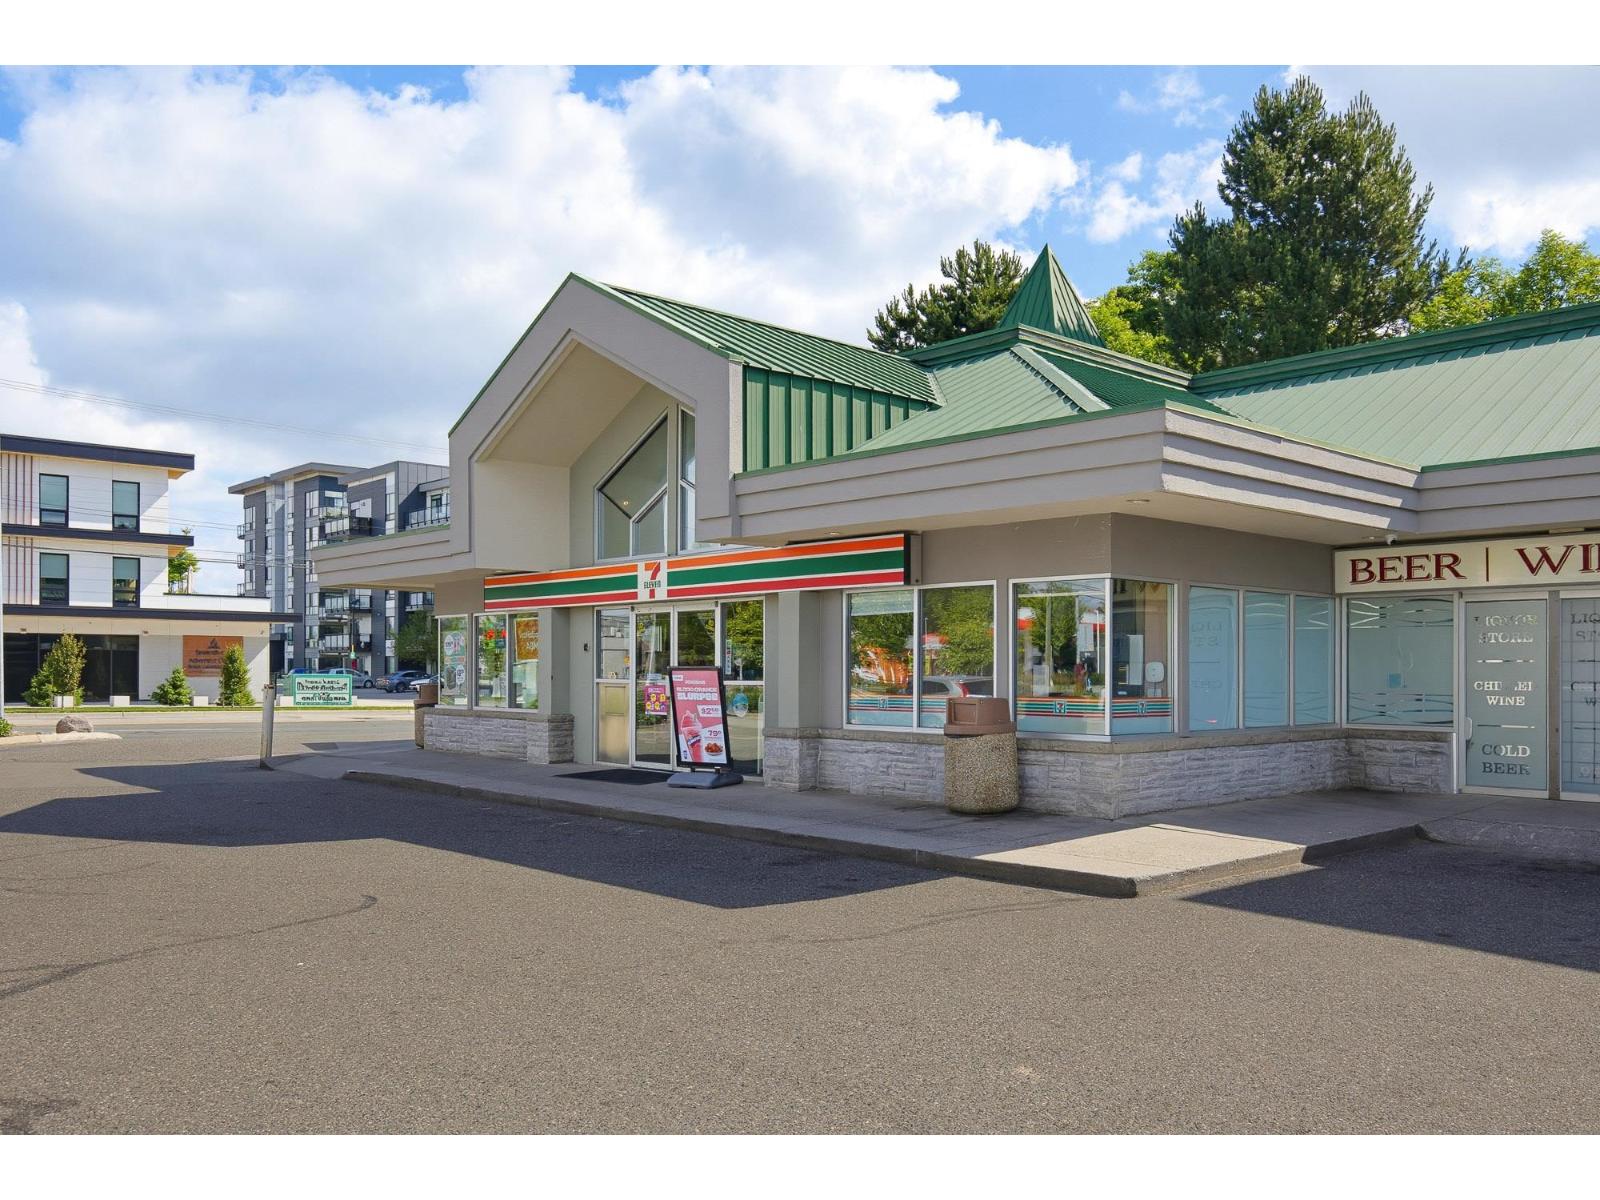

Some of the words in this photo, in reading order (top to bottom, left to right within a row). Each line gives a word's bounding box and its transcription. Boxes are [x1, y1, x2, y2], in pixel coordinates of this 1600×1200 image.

[1349, 553, 1467, 585] BEER
[645, 561, 660, 599] 7
[1486, 695, 1525, 706] WINE
[1481, 743, 1530, 757] COLD
[1481, 762, 1530, 775] BEER
